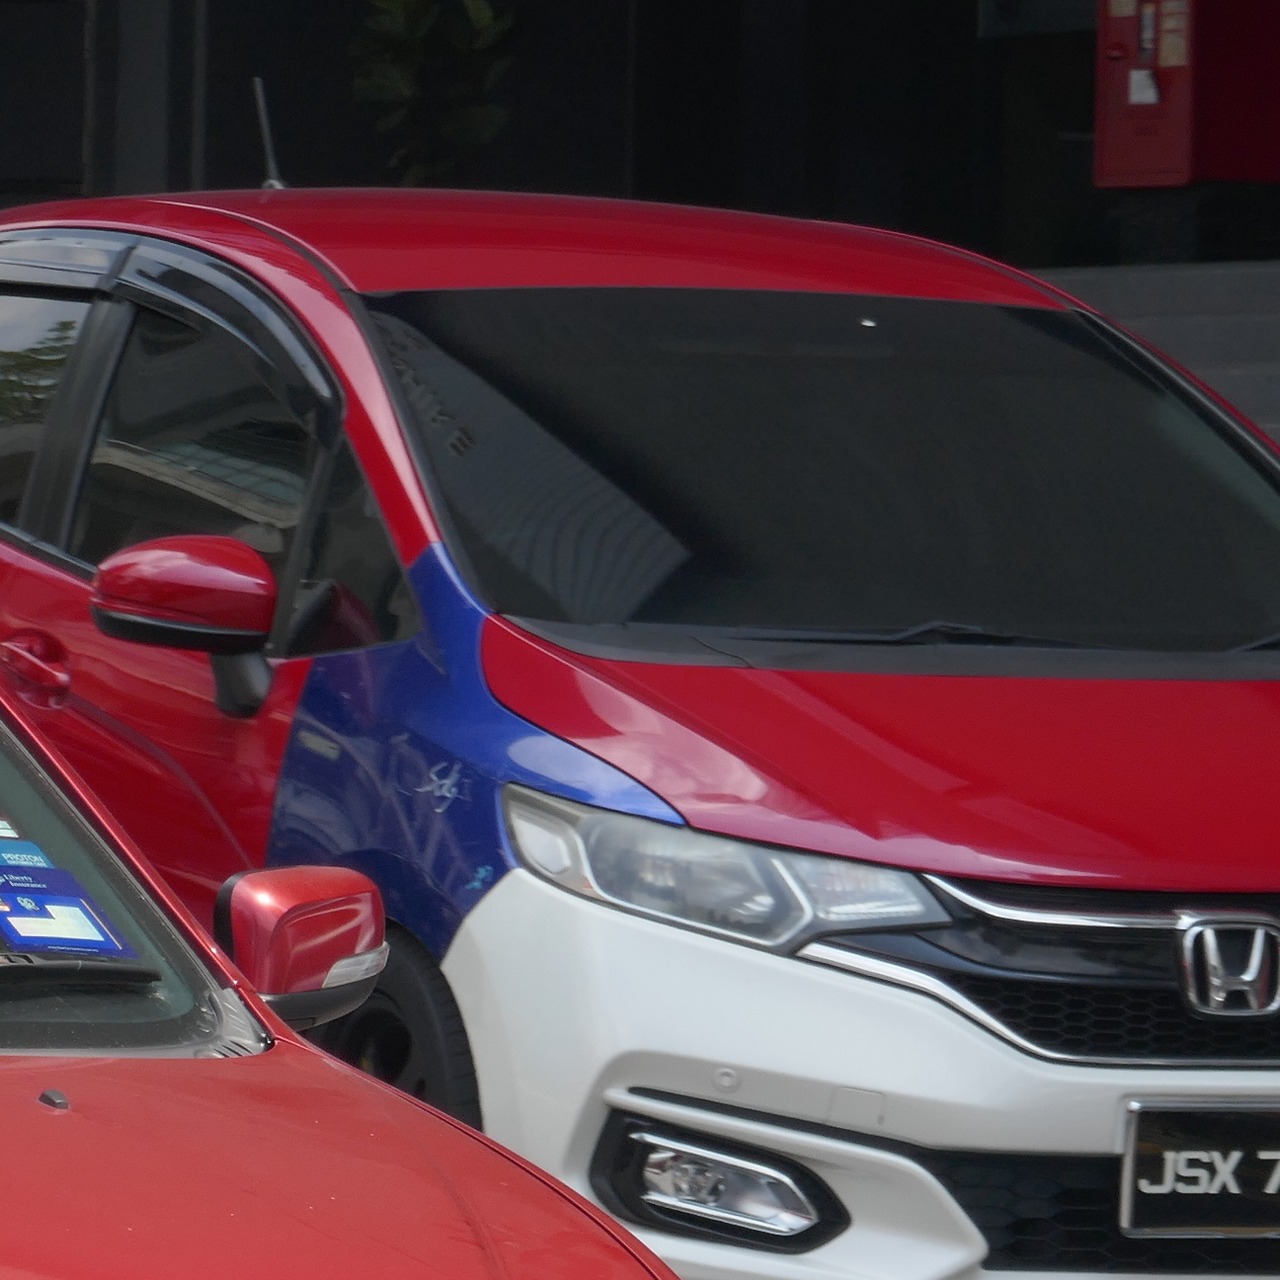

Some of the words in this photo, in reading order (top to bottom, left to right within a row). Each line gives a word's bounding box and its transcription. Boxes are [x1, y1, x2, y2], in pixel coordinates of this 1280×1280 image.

[1, 853, 45, 863] PROTON
[3, 874, 33, 883] Liberty
[9, 881, 48, 889] Insurance
[1137, 1150, 1243, 1195] JSX
